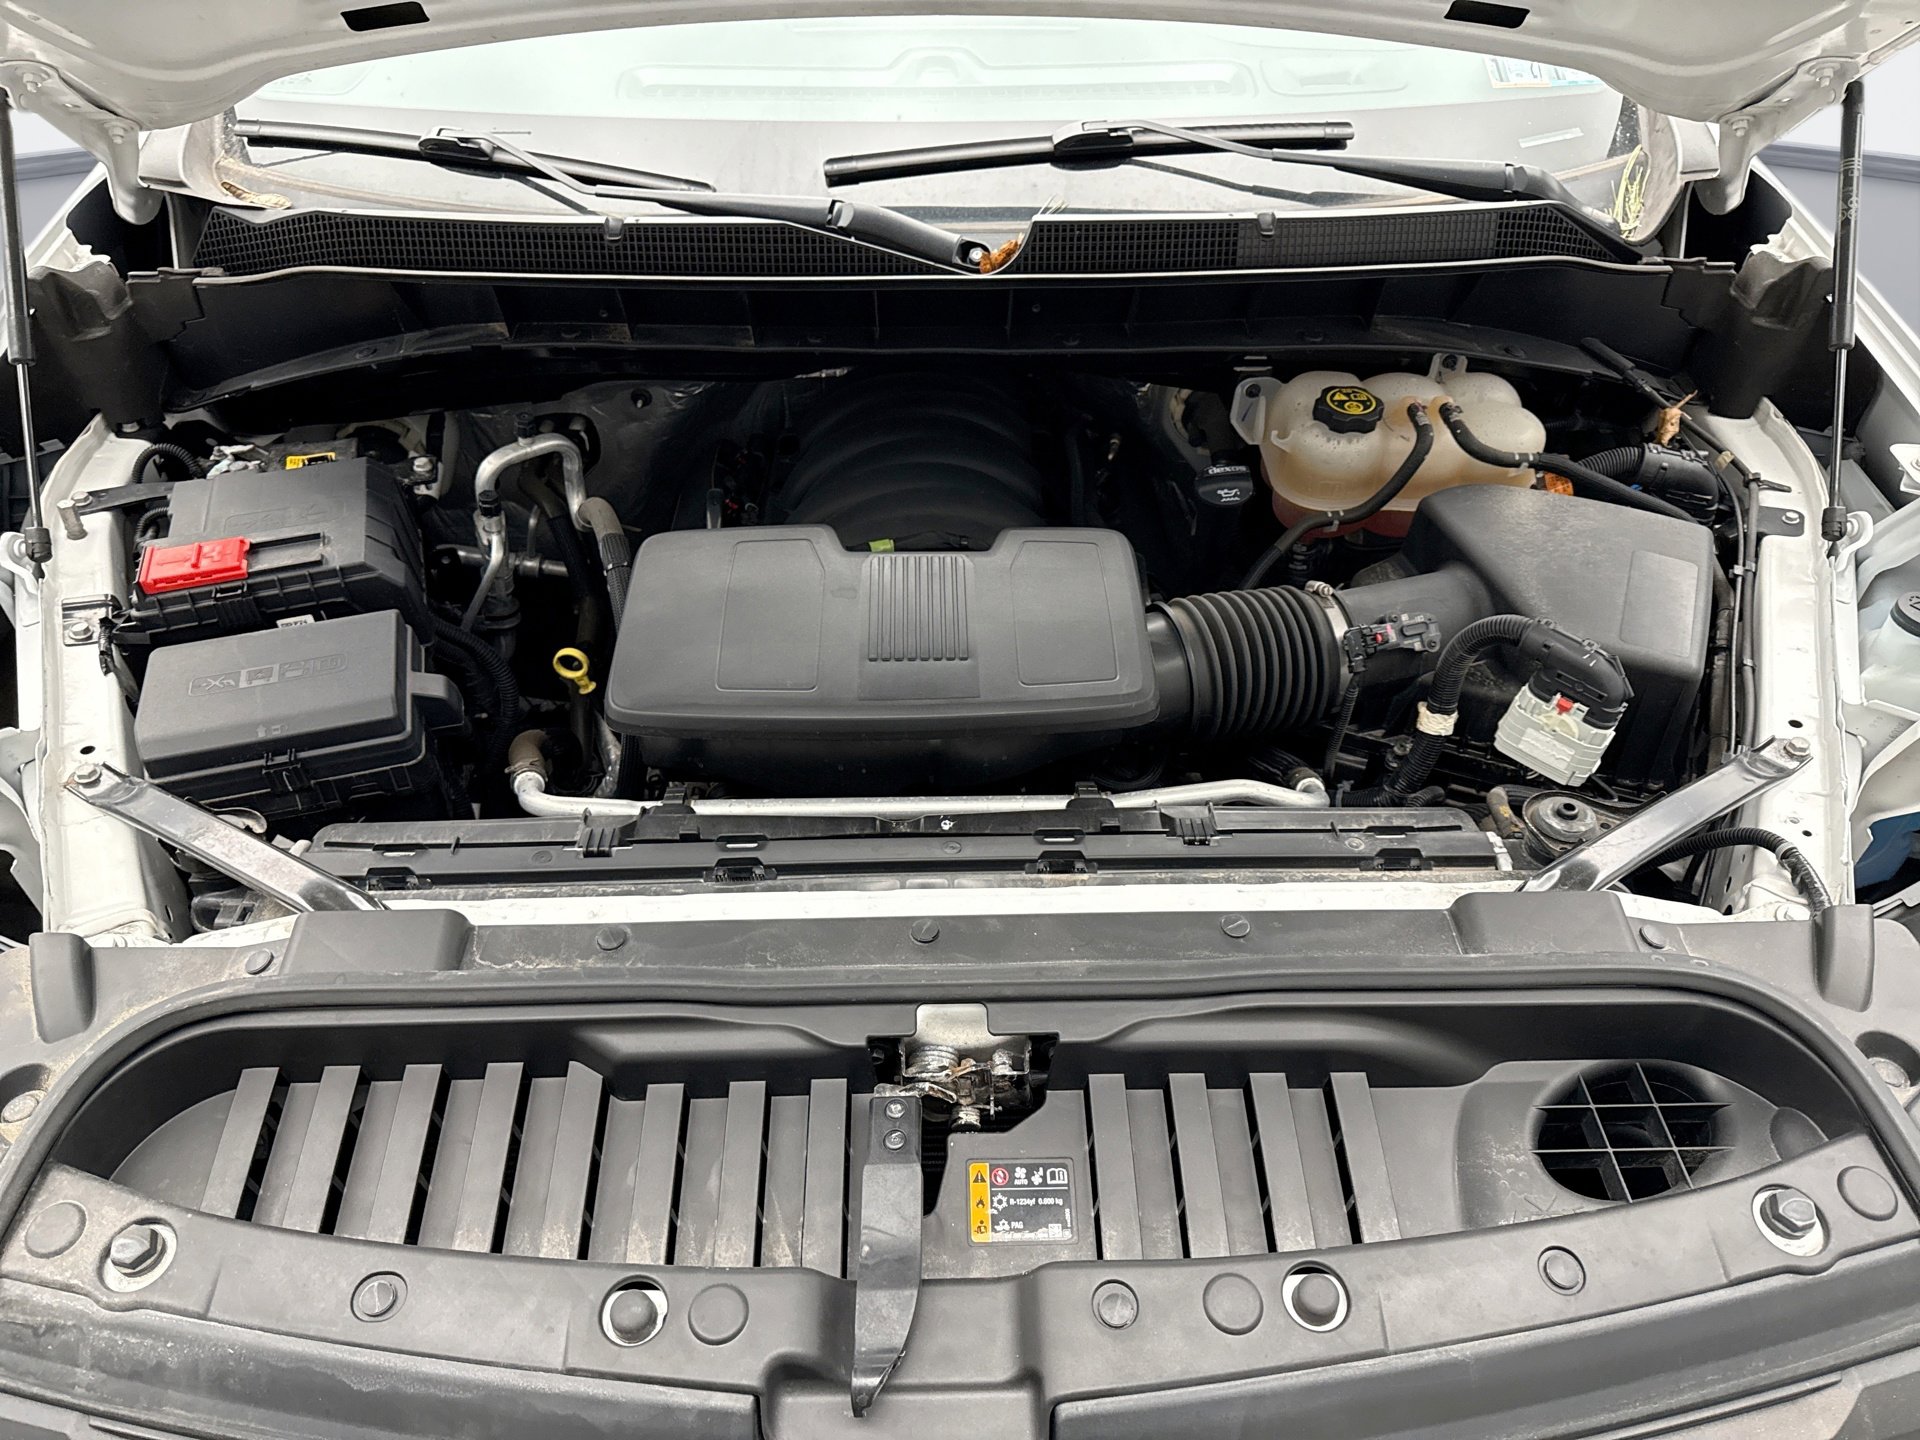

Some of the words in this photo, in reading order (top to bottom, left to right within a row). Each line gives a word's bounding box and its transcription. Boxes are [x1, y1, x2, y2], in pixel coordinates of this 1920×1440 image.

[1208, 466, 1247, 475] dexos
[1014, 1178, 1028, 1186] AUTO
[1009, 1197, 1035, 1207] R-1234yf
[1055, 1197, 1063, 1207] kg
[1011, 1221, 1024, 1229] PAG
